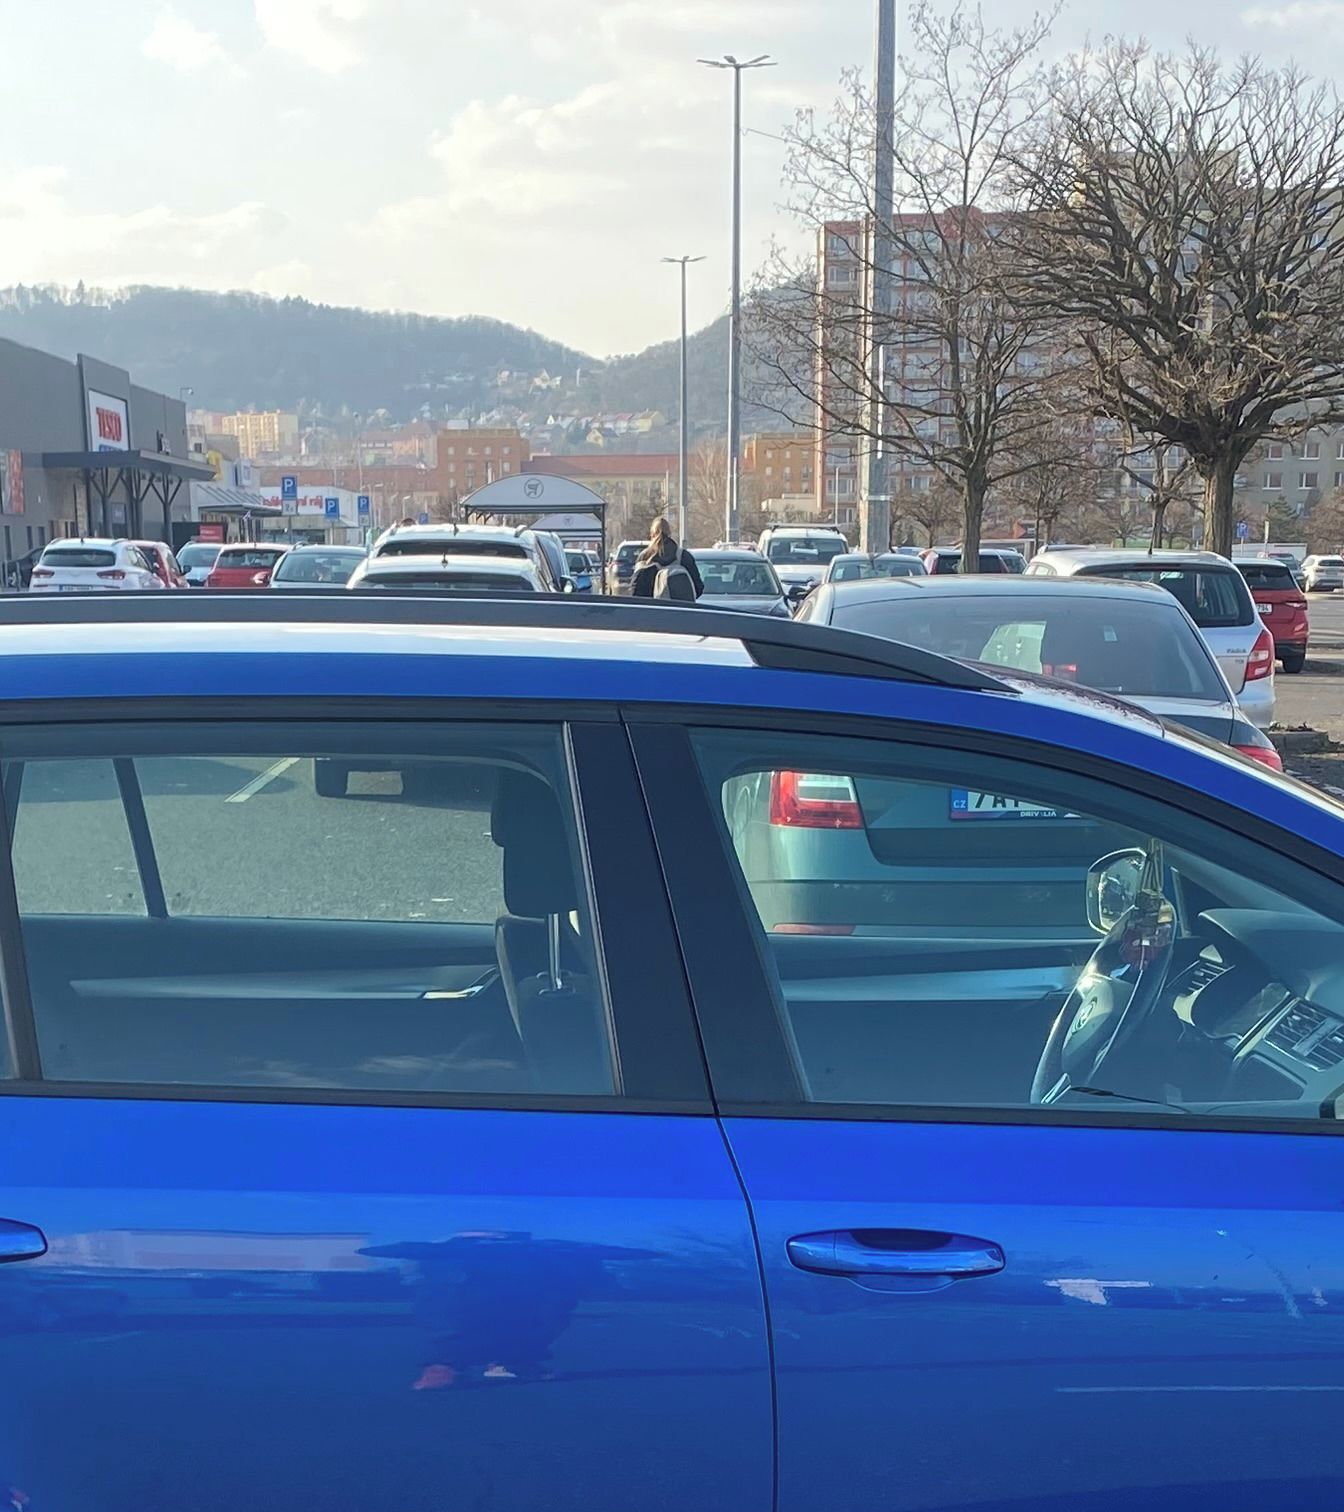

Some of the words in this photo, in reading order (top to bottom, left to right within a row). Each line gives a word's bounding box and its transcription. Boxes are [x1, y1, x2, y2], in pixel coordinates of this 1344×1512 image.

[96, 407, 122, 442] TESCO
[284, 479, 294, 492] P
[328, 500, 336, 512] P
[360, 498, 368, 509] P
[953, 799, 966, 809] CZ
